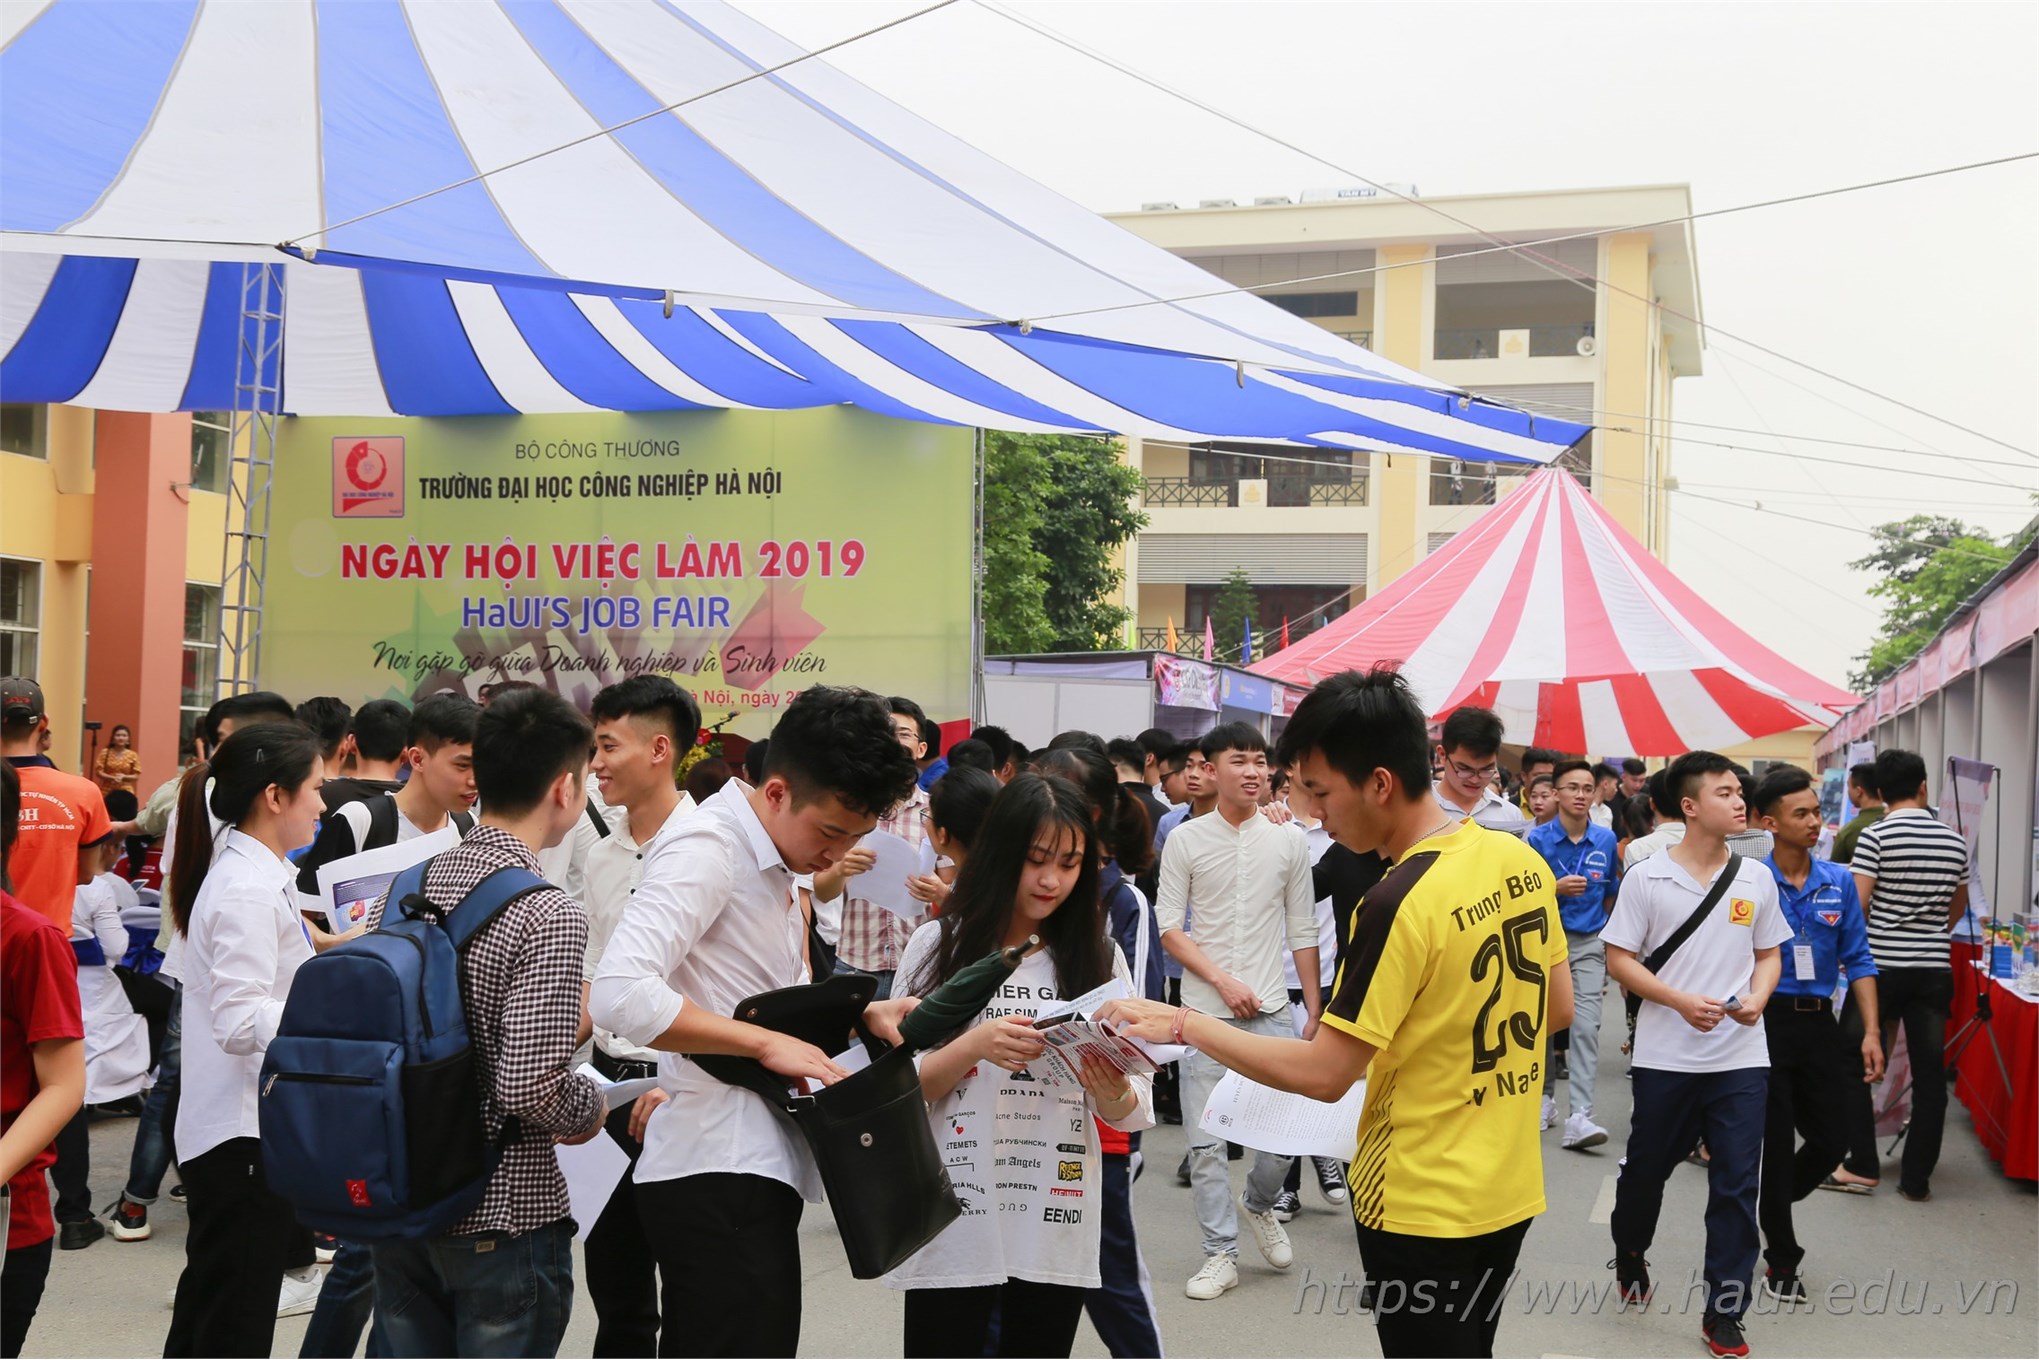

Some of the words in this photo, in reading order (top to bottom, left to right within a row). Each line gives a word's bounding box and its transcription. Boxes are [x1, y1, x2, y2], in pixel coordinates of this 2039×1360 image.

[515, 440, 540, 462] BỘ
[545, 439, 597, 459] CÔNG
[604, 440, 680, 458] THƯƠNG
[419, 471, 492, 499] TRƯỜNG
[498, 477, 529, 504] ĐẠI
[536, 476, 573, 503] HỌC
[579, 471, 631, 499] CÔNG
[638, 469, 709, 501] NGHIỆP
[716, 467, 741, 495] HÀ
[748, 467, 782, 499] NỘI
[341, 535, 451, 580] NGÀY
[464, 535, 537, 590] HỘI
[551, 535, 640, 589] VIỆC
[656, 533, 743, 579] LÀM
[758, 540, 866, 578] 2019
[579, 597, 641, 634] JOB
[652, 597, 731, 628] FAIR
[373, 640, 411, 671] Nơi
[414, 650, 454, 681] gặp
[487, 651, 534, 683] giữa
[540, 644, 611, 673] Doanh
[615, 648, 687, 681] nghiệp
[692, 650, 719, 674] và
[726, 644, 780, 675] Sinh
[782, 652, 828, 673] viên
[703, 690, 736, 708] Nội,
[740, 690, 780, 709] ngày
[1505, 870, 1542, 900] Béo
[1470, 906, 1549, 1075] 25
[1070, 1118, 1083, 1133] YZ
[1008, 1156, 1042, 1169] Angels
[1043, 1207, 1082, 1224] EENDI
